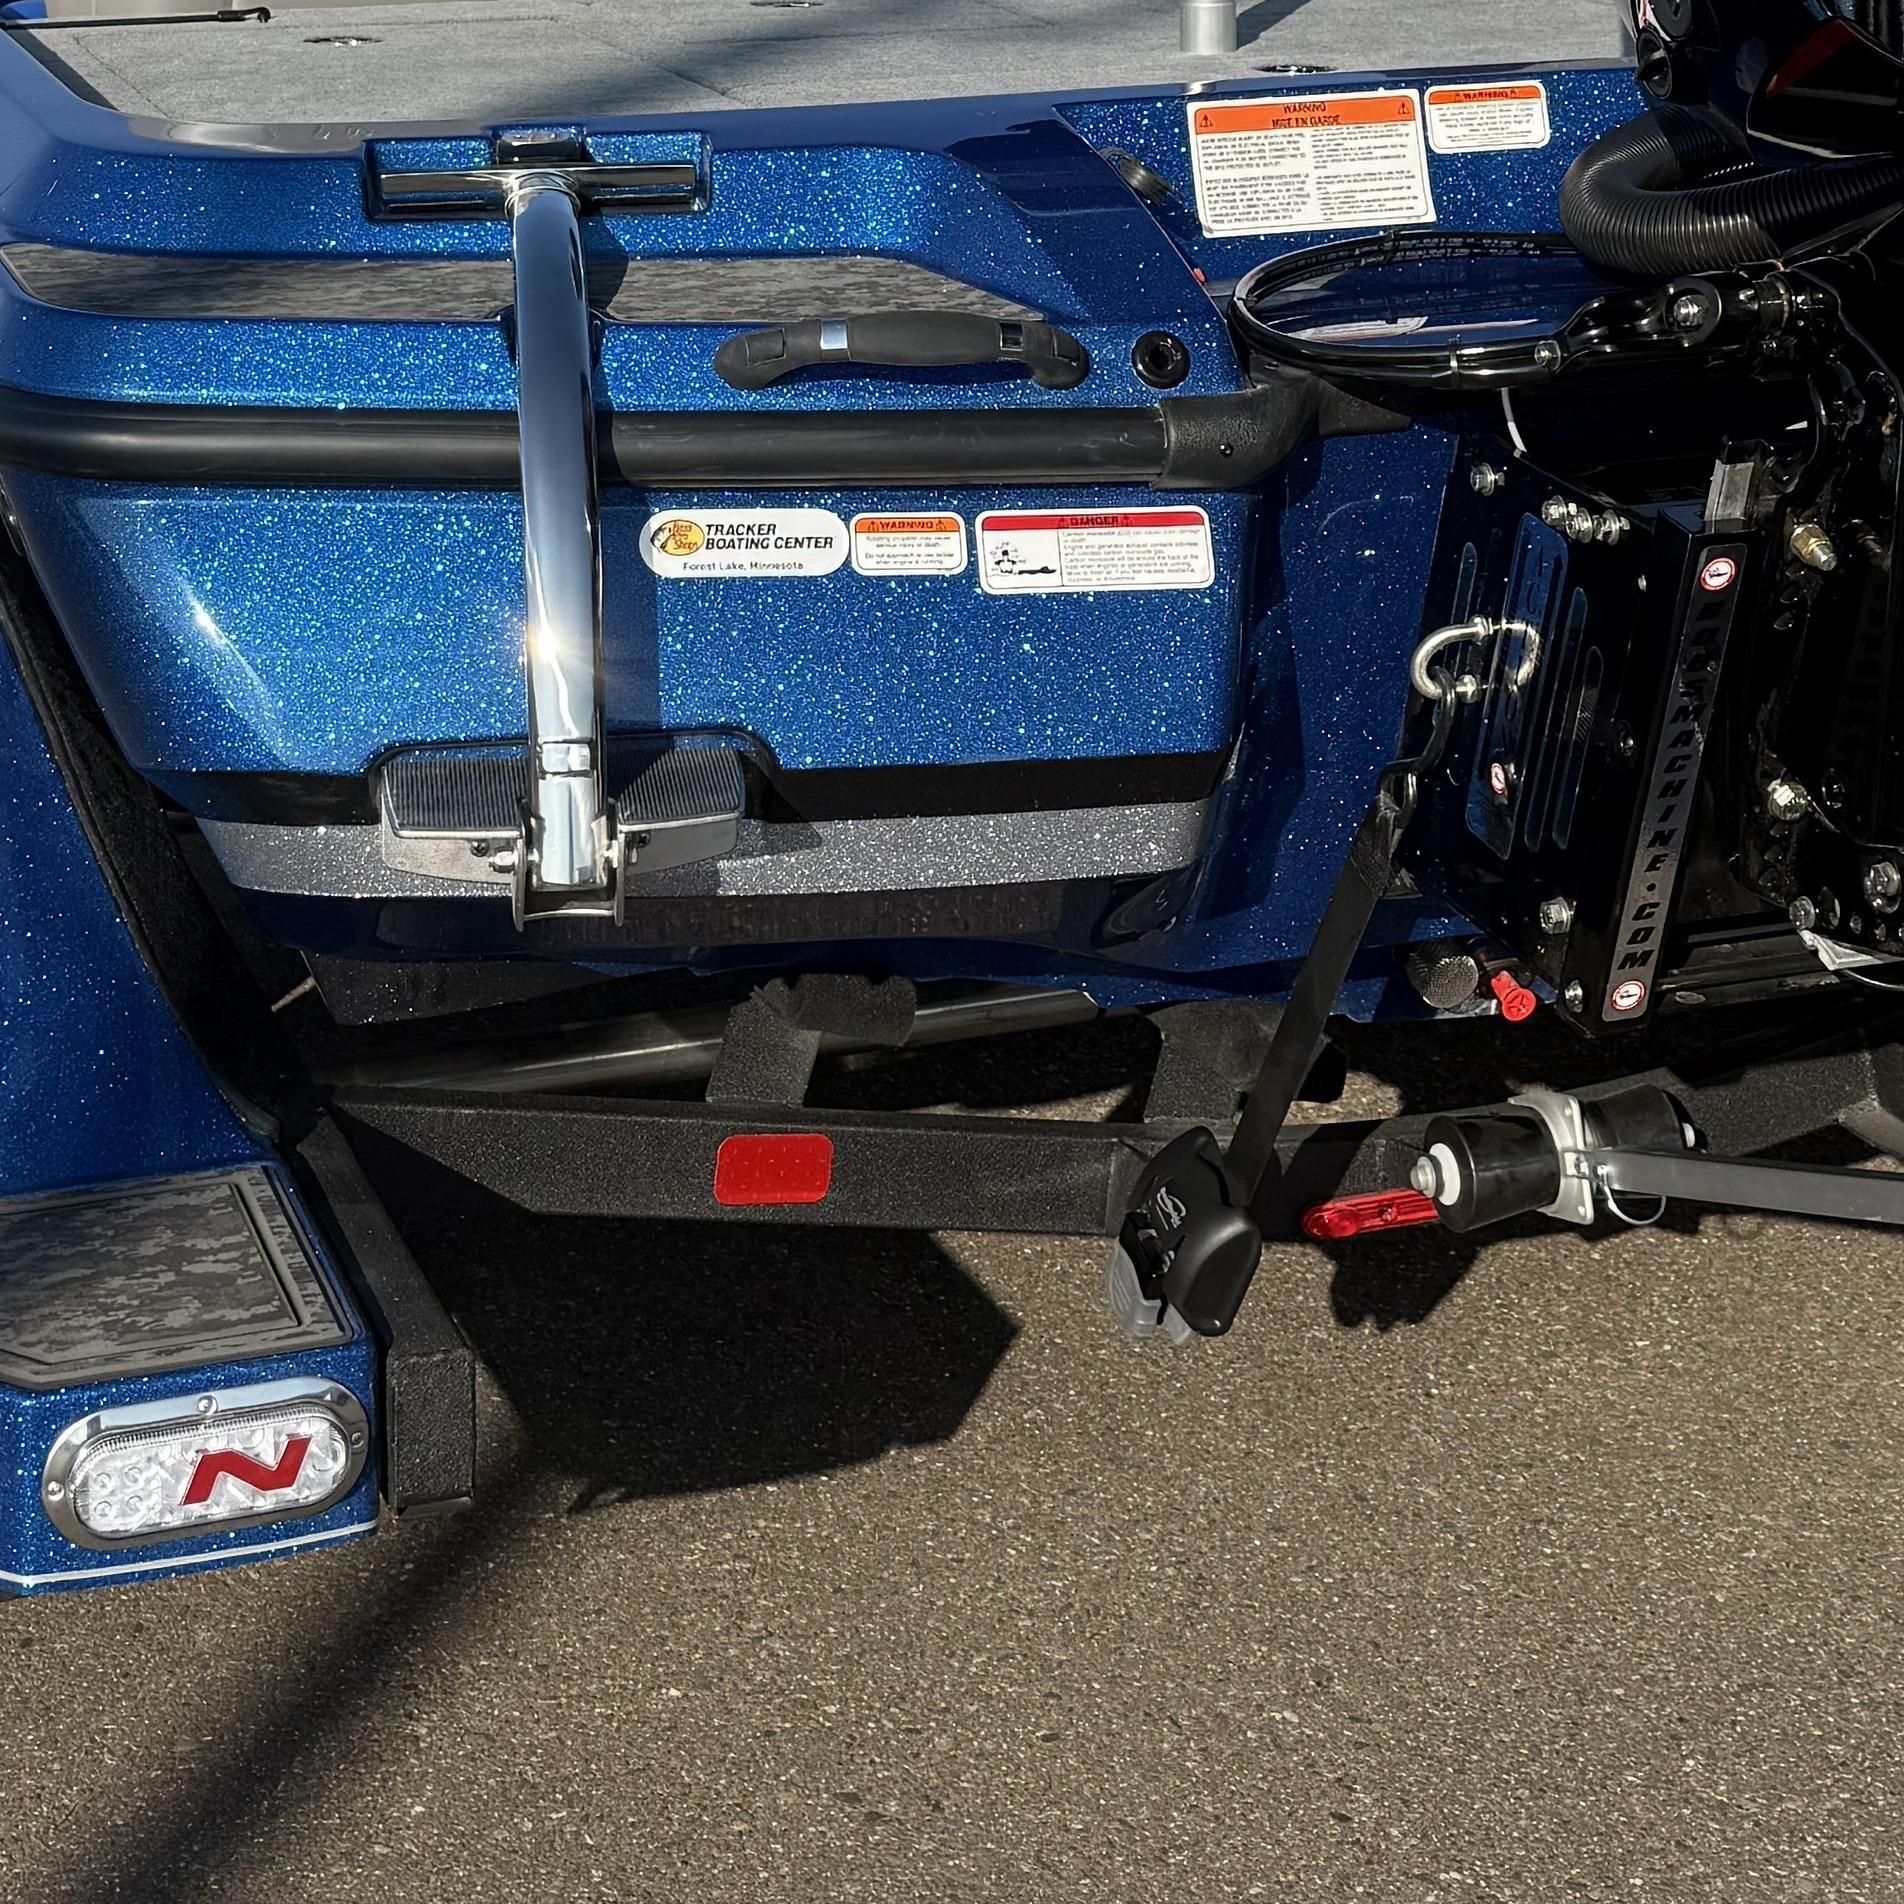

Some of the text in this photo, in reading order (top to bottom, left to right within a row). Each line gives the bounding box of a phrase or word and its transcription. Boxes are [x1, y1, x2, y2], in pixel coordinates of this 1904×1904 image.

[705, 523, 777, 536] TRACKER
[705, 536, 834, 550] BOATING CENTER
[683, 561, 716, 571] Forest
[750, 560, 804, 571] Minnesota
